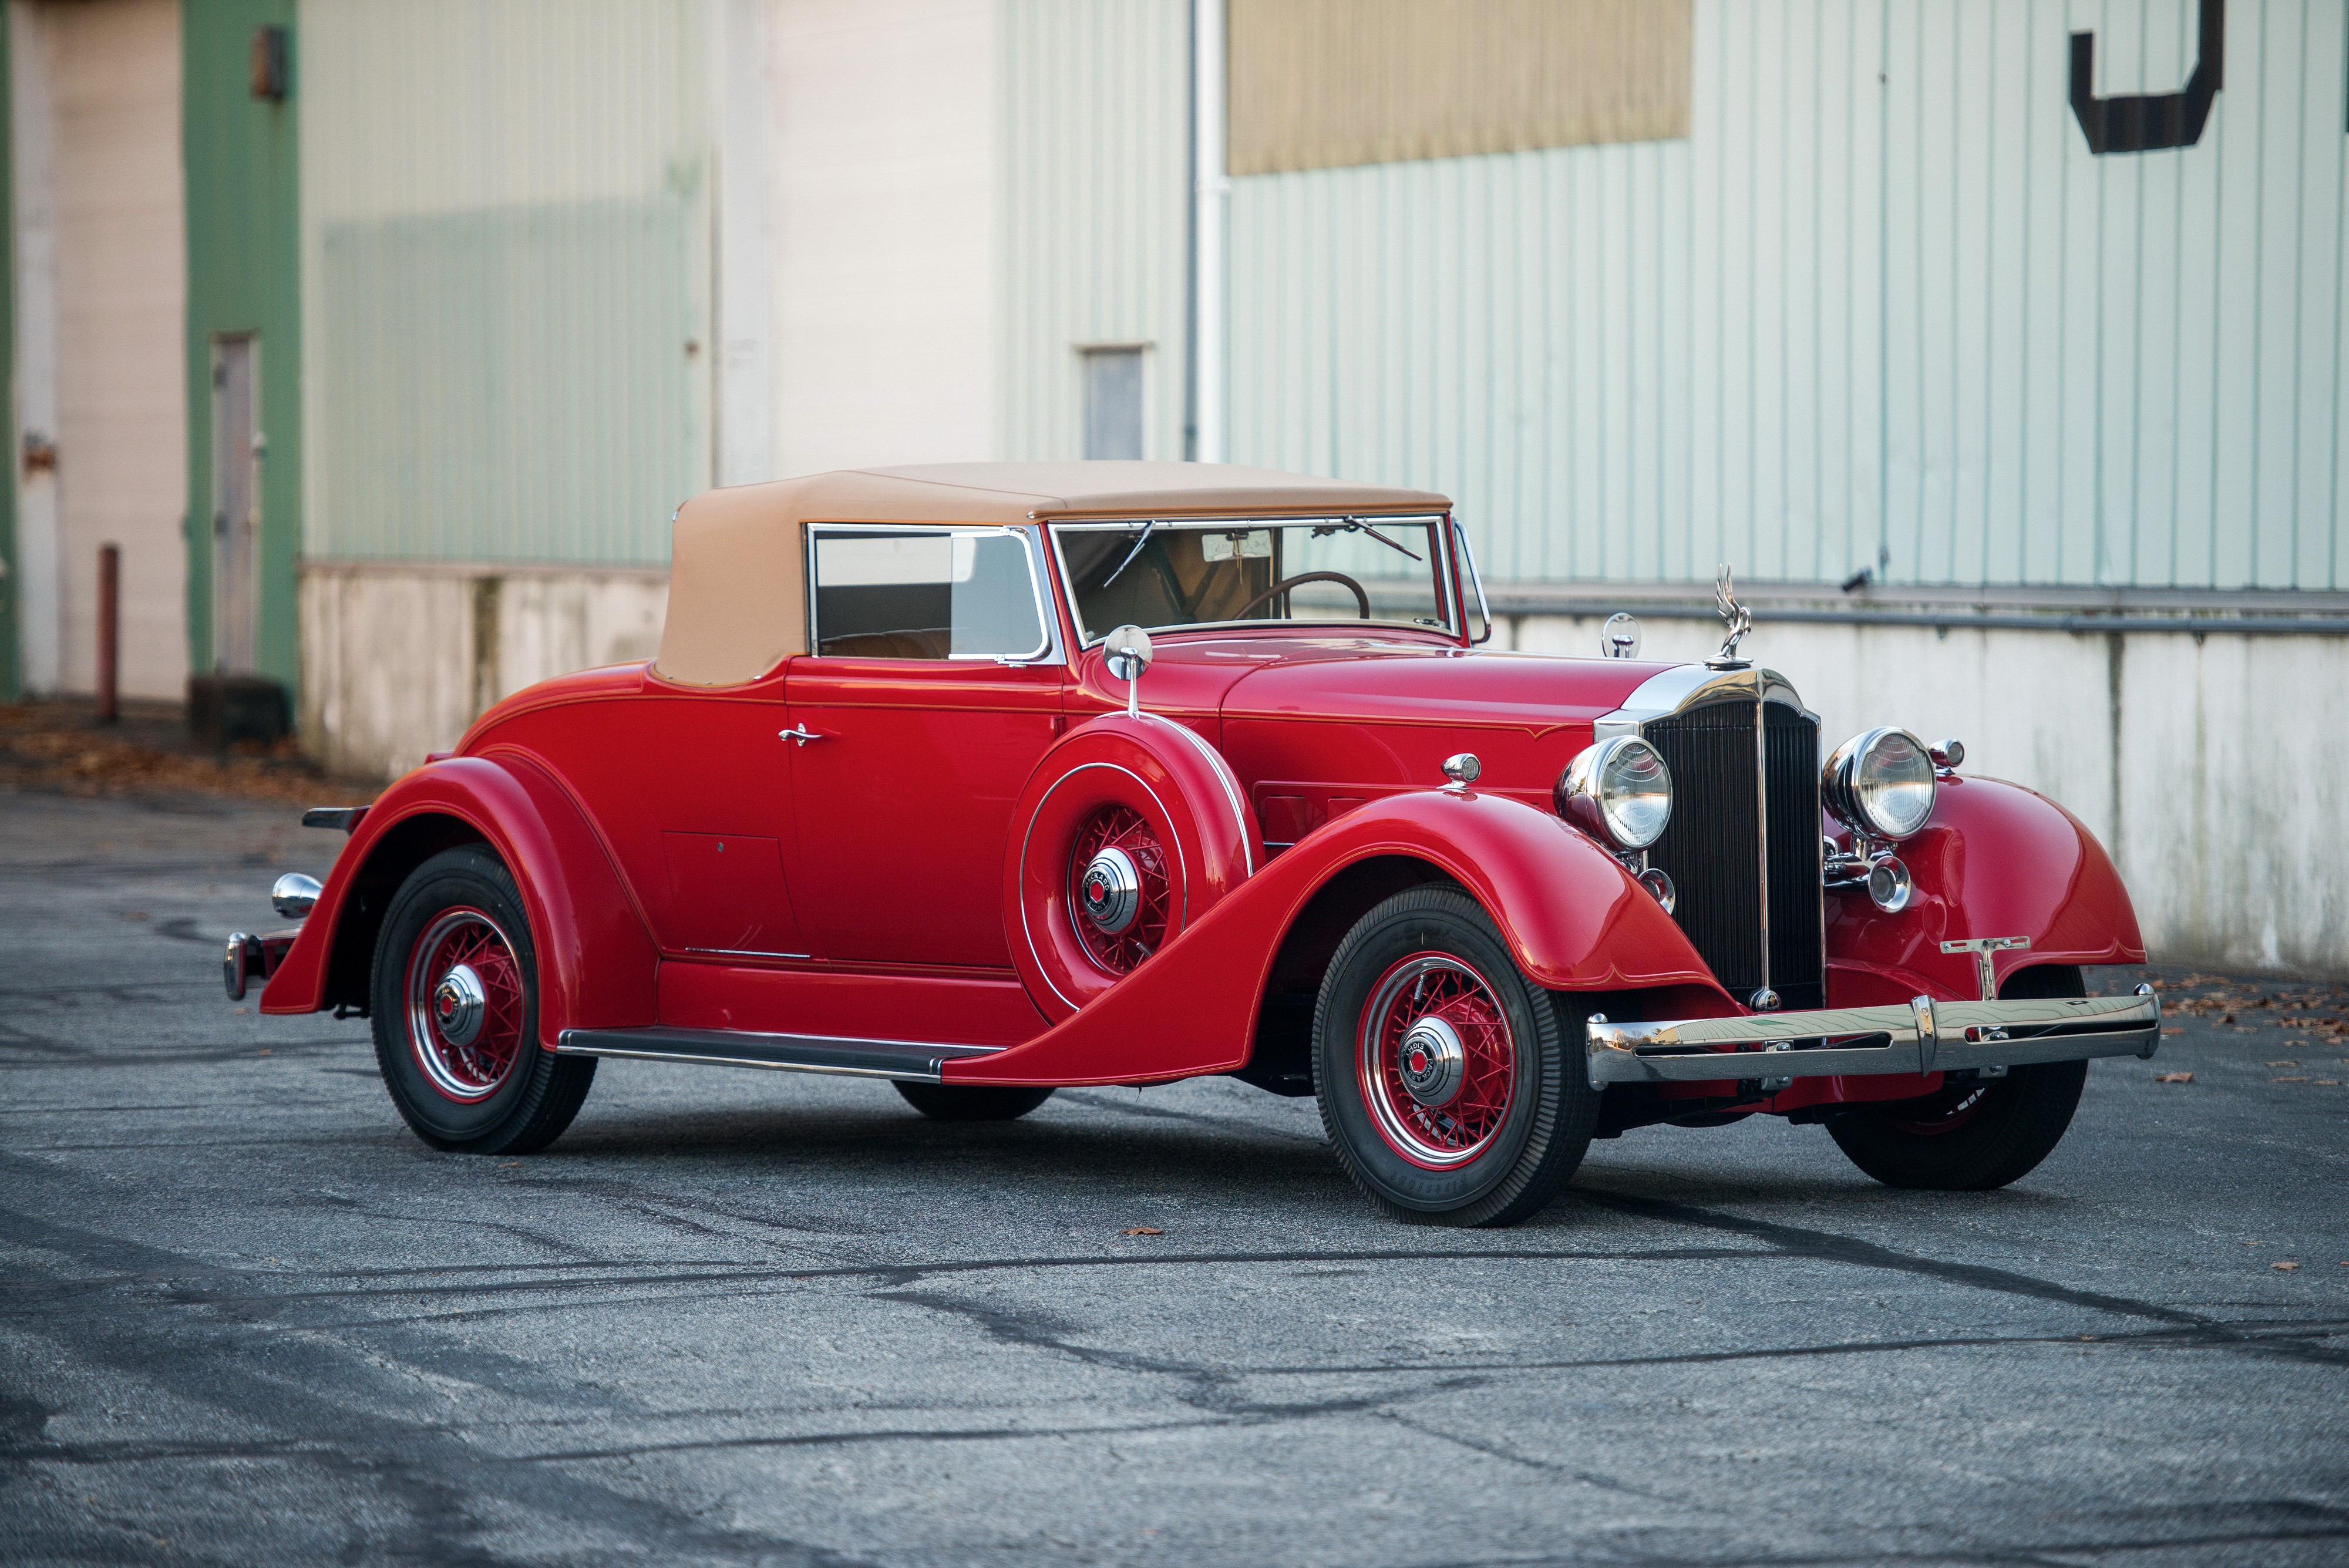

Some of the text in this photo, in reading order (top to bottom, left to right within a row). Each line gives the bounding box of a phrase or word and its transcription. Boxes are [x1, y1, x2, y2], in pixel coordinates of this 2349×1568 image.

[1085, 873, 1110, 891] PACKARD
[1405, 1042, 1425, 1056] EIGHT
[1407, 1058, 1433, 1082] PACKARD
